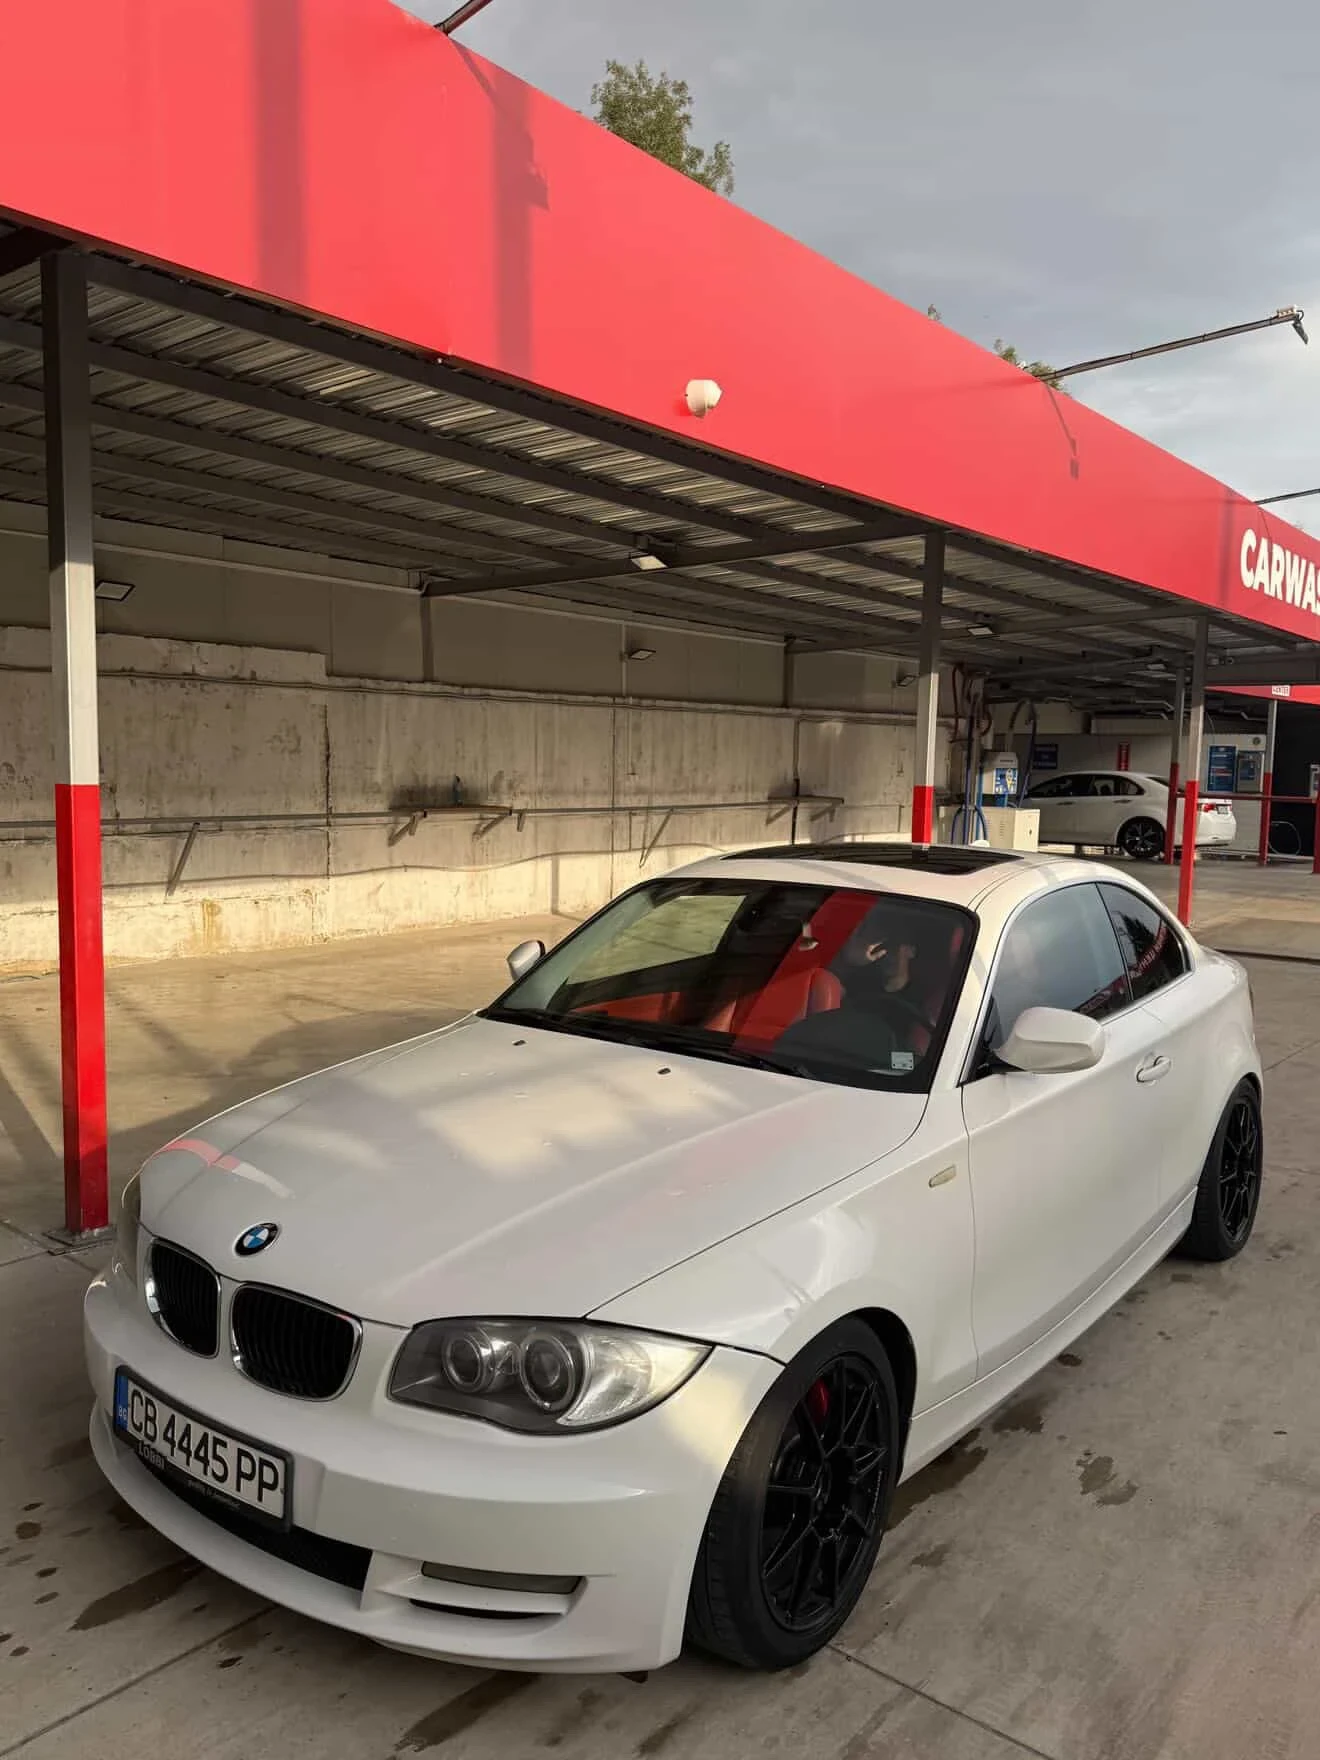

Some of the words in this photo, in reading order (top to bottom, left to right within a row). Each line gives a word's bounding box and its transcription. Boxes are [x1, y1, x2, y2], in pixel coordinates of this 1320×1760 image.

[131, 1389, 159, 1442] CB
[162, 1413, 229, 1484] 4445
[236, 1447, 279, 1503] PP
